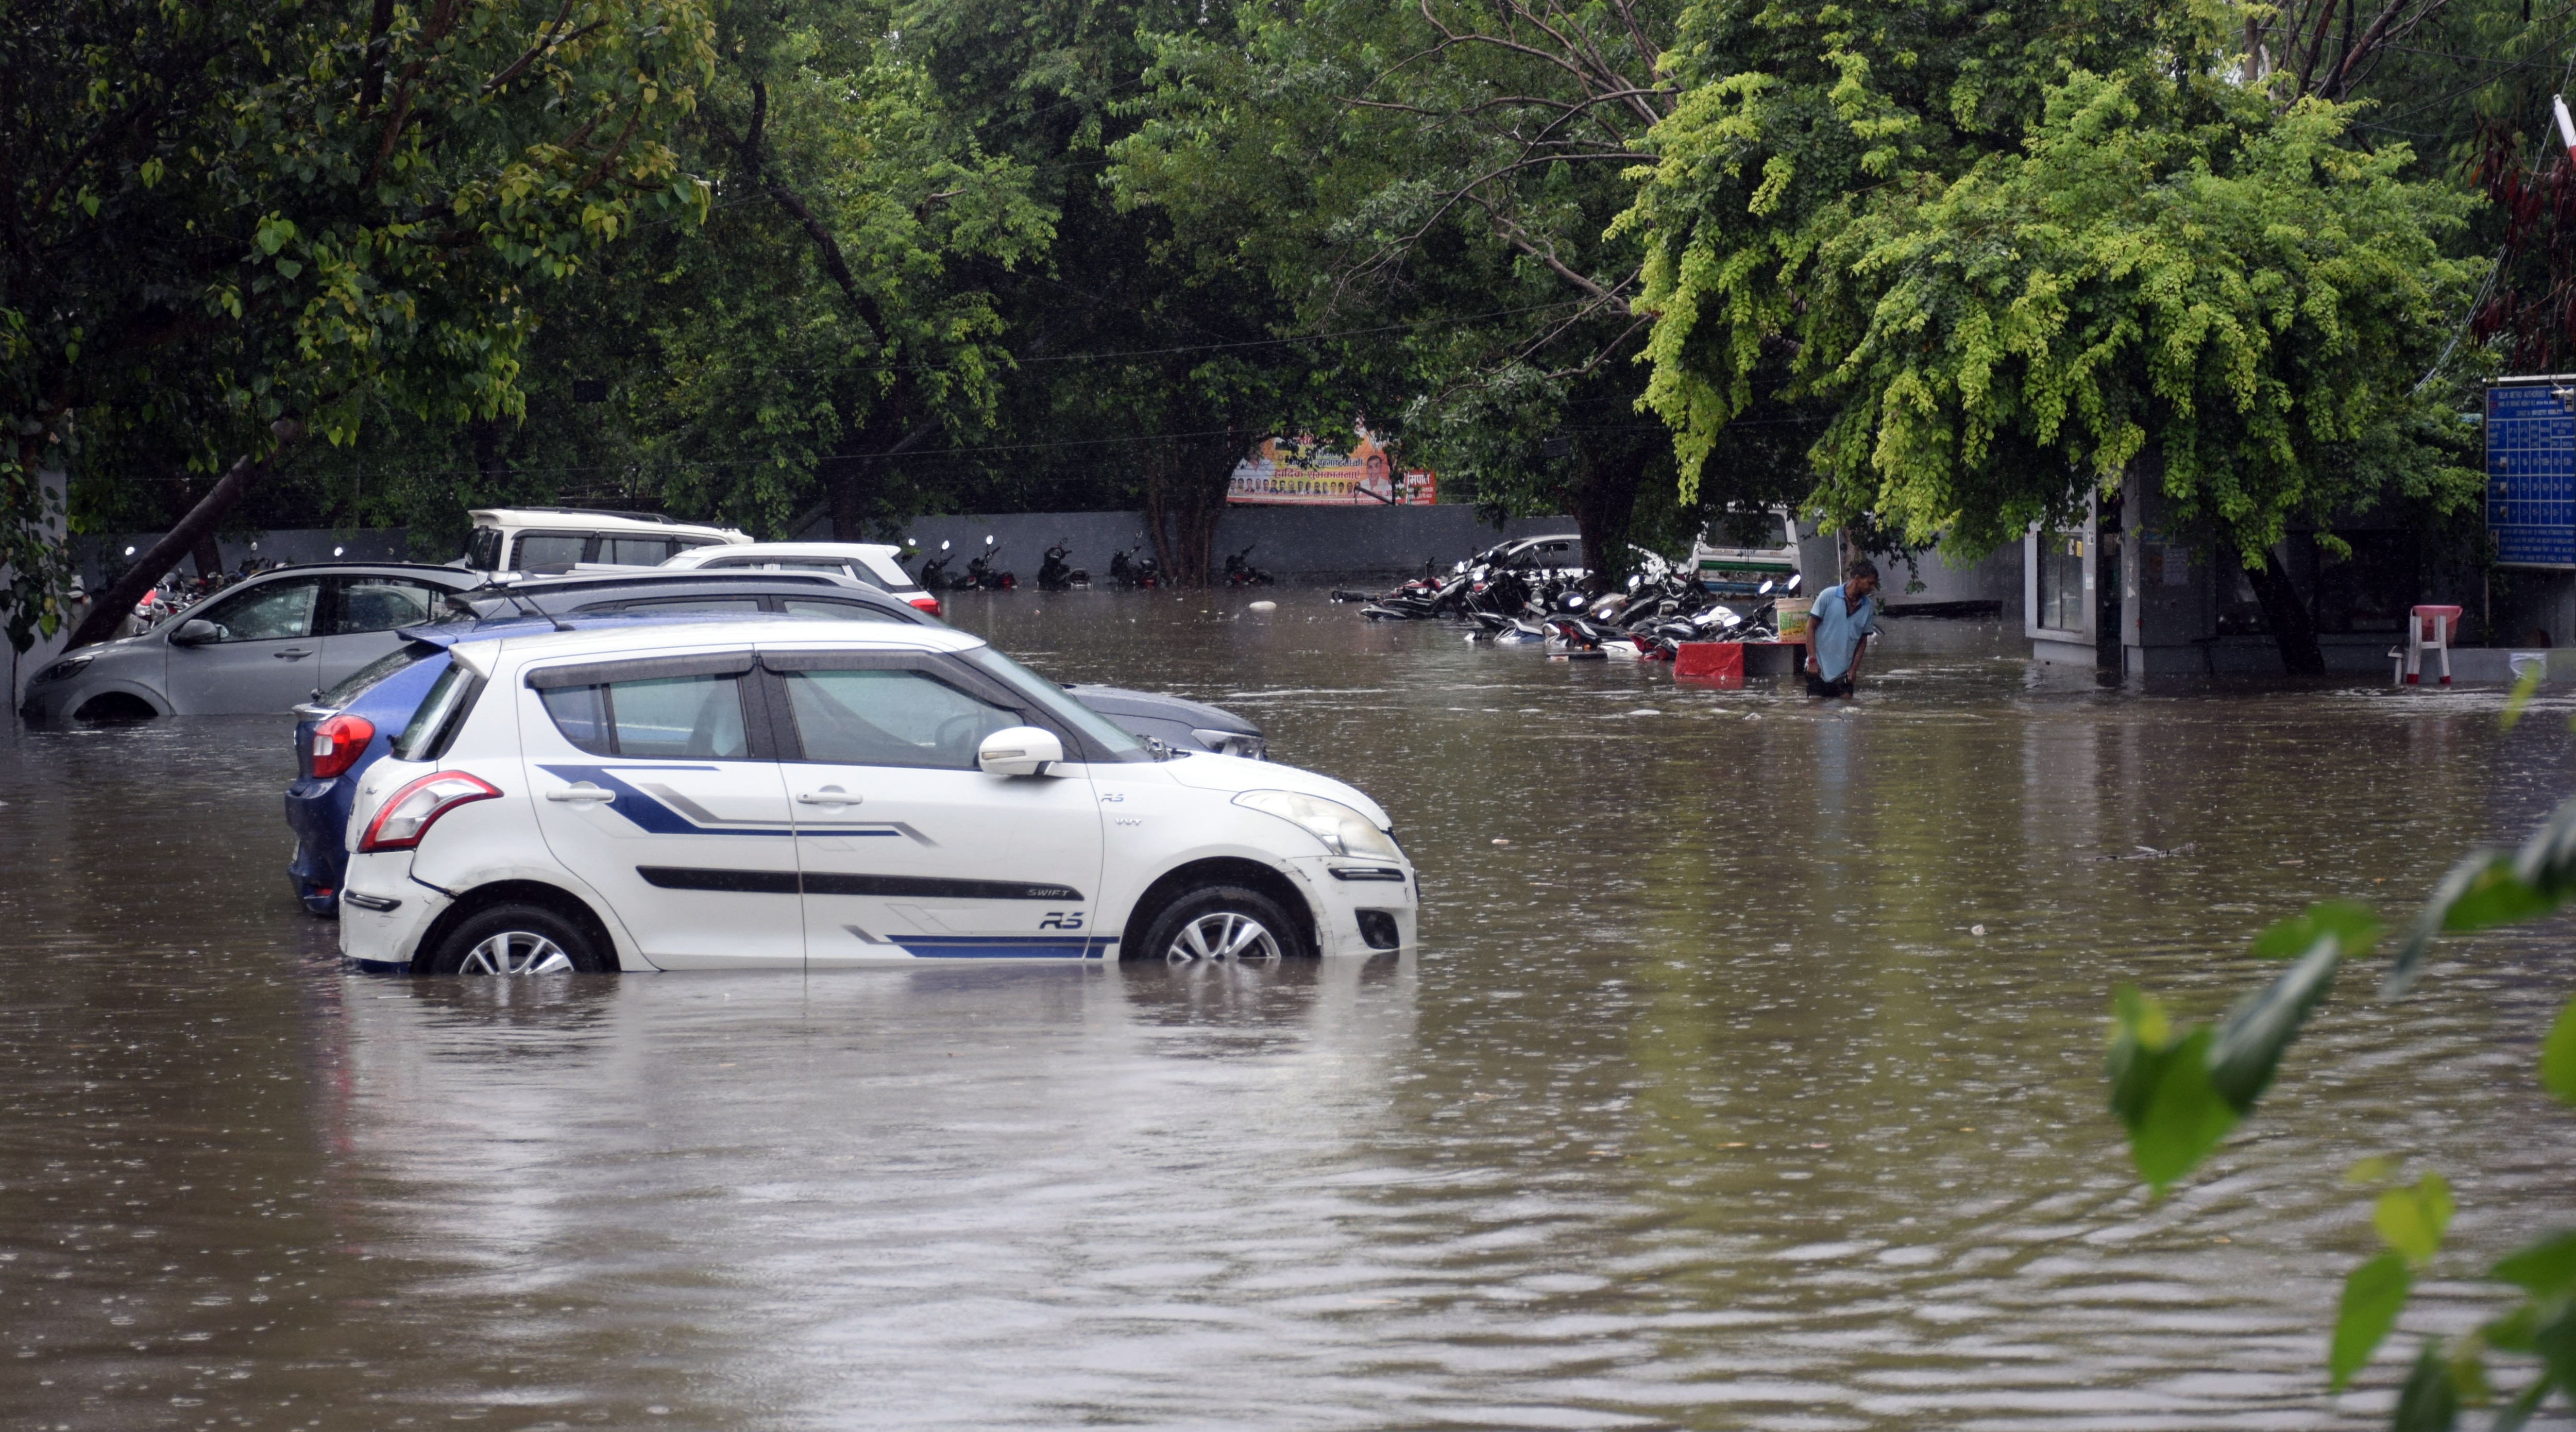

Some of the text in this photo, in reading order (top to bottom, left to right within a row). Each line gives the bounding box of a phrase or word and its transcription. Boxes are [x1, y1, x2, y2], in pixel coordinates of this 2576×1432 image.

[1275, 467, 1303, 479] हार्दिक
[1101, 794, 1124, 802] RS
[1115, 817, 1142, 826] VVT
[1039, 912, 1084, 929] RS
